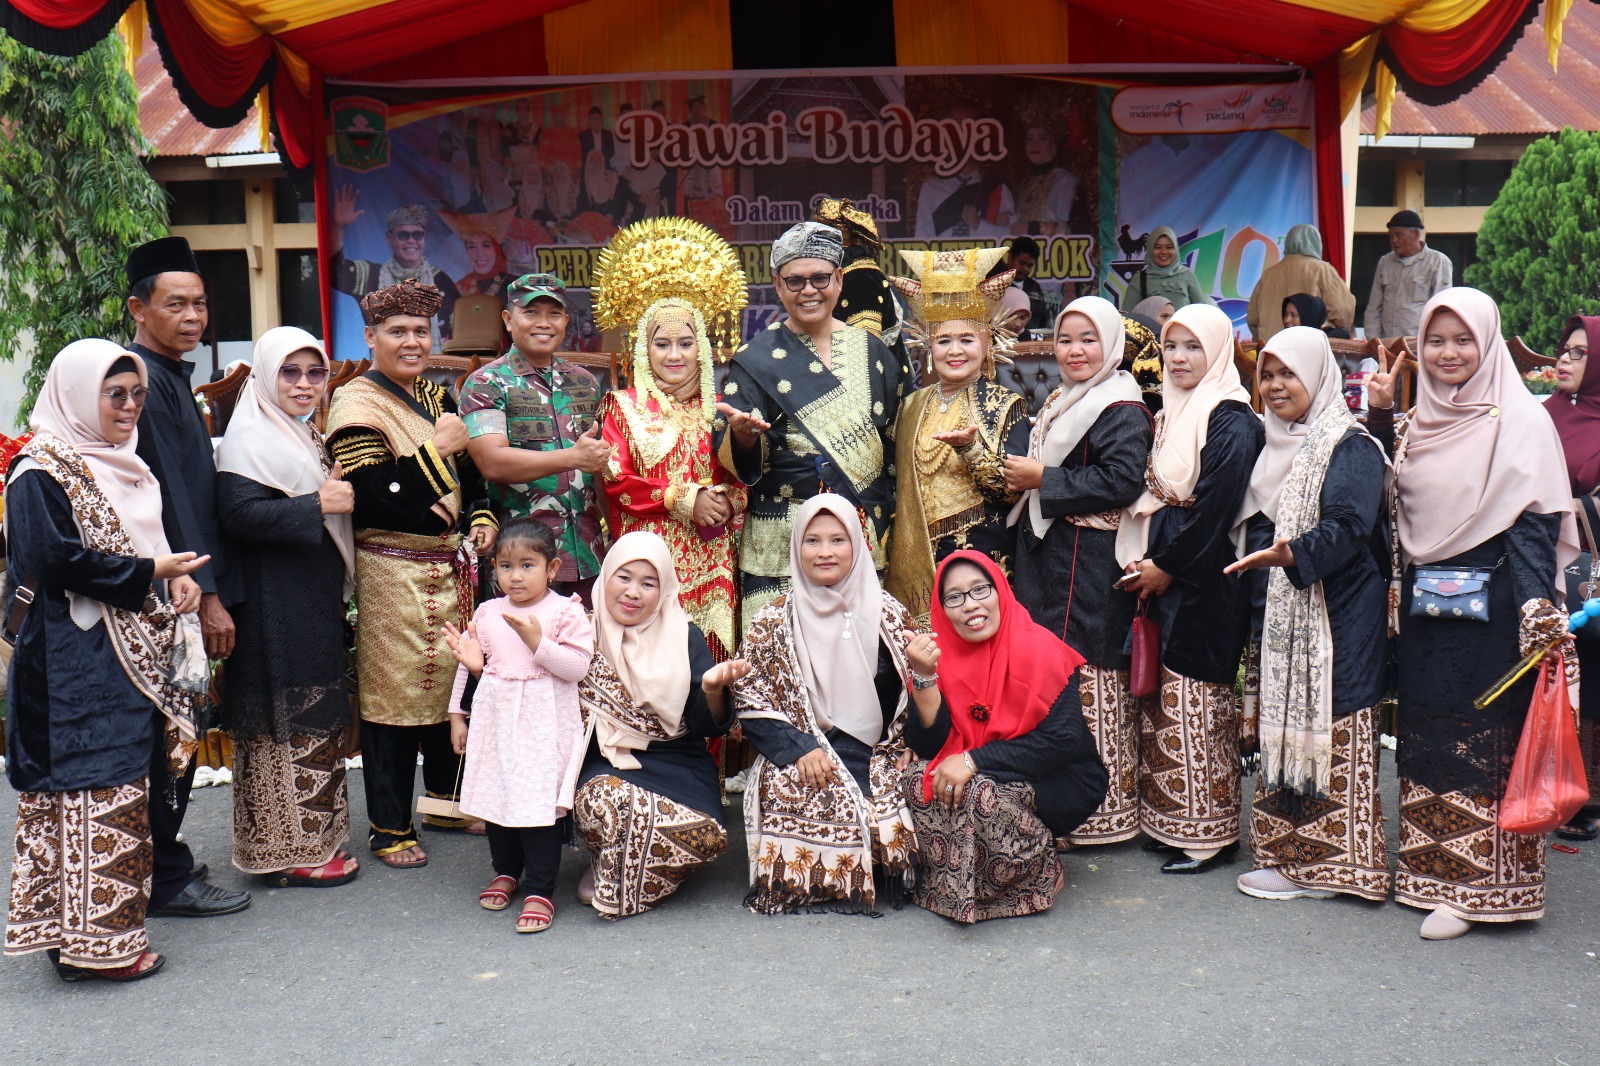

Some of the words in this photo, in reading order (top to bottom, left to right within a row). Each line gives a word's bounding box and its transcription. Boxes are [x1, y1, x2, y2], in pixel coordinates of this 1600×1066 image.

[1129, 109, 1171, 118] indonesia
[1205, 110, 1245, 122] padang
[616, 110, 788, 168] Pawai
[796, 105, 1007, 177] Budaya
[727, 195, 804, 224] Dalam
[1002, 237, 1091, 279] LOK
